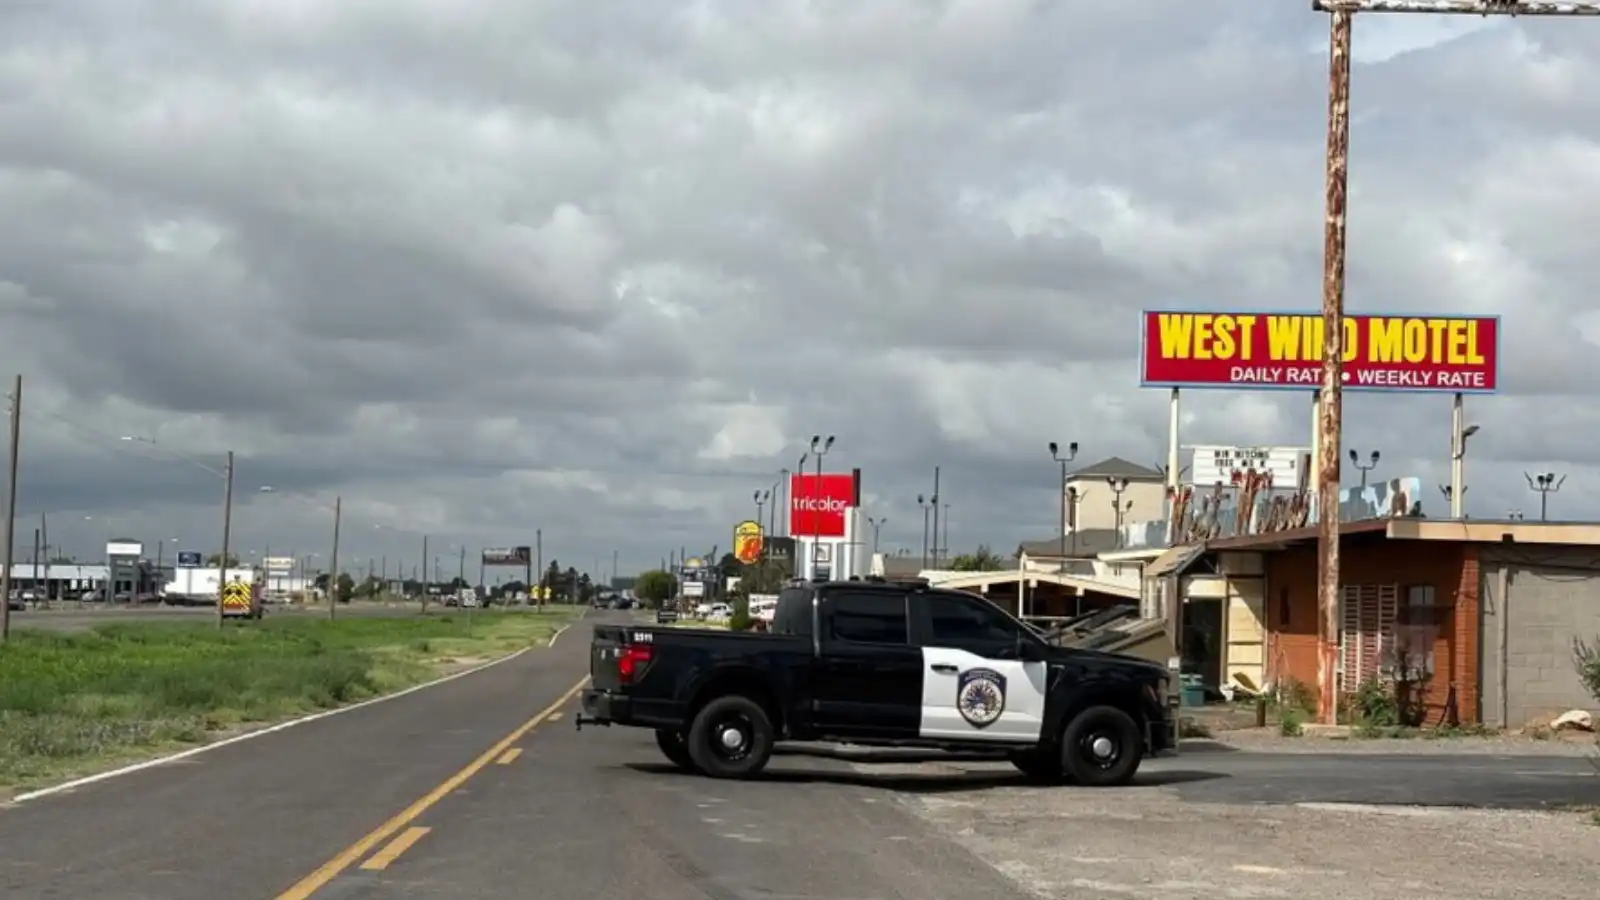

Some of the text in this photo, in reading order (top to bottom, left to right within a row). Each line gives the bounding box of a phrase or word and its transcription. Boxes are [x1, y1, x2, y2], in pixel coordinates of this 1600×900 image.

[1158, 313, 1256, 360] WEST
[1368, 318, 1485, 364] MOTEL
[1230, 366, 1485, 387] DAILY RAT WEEKLY RATE
[793, 496, 847, 512] tricolor
